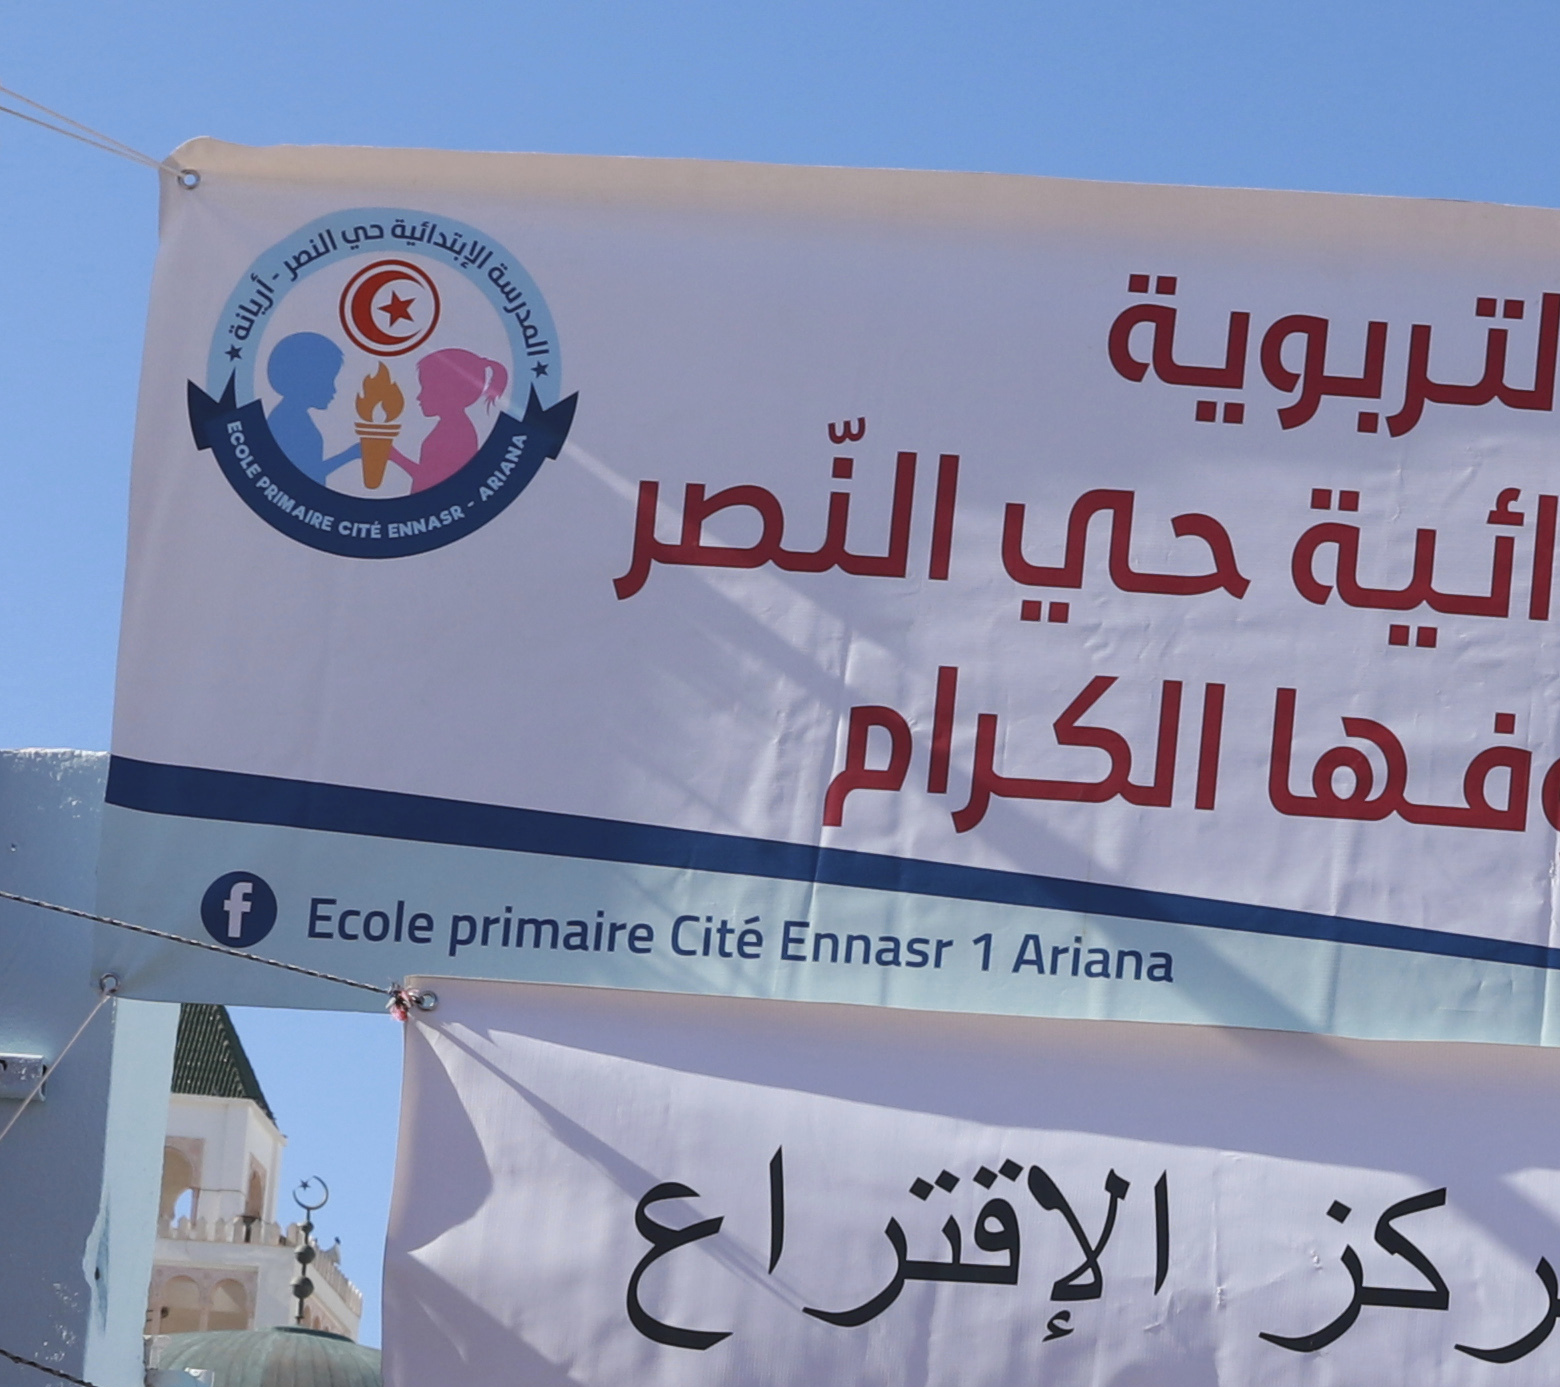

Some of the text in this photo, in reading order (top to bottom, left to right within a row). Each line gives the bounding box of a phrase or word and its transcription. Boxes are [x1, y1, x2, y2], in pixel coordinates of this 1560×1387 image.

[283, 229, 338, 283] النصر
[341, 221, 385, 251] حي
[226, 271, 276, 342] أريانة
[486, 261, 550, 358] المدرسة
[226, 419, 261, 479] ECOLE
[255, 478, 335, 532] PRIMAIRE
[337, 519, 383, 540] CITÉ
[387, 504, 466, 539] ENNASR
[477, 434, 528, 502] ARIANA
[1004, 490, 1250, 623] حي
[822, 665, 1225, 832] الكرام
[307, 898, 1175, 984] Ecole primaire Cité Ennasr 1 Ariana
[626, 1146, 1171, 1352] الإقتراع
